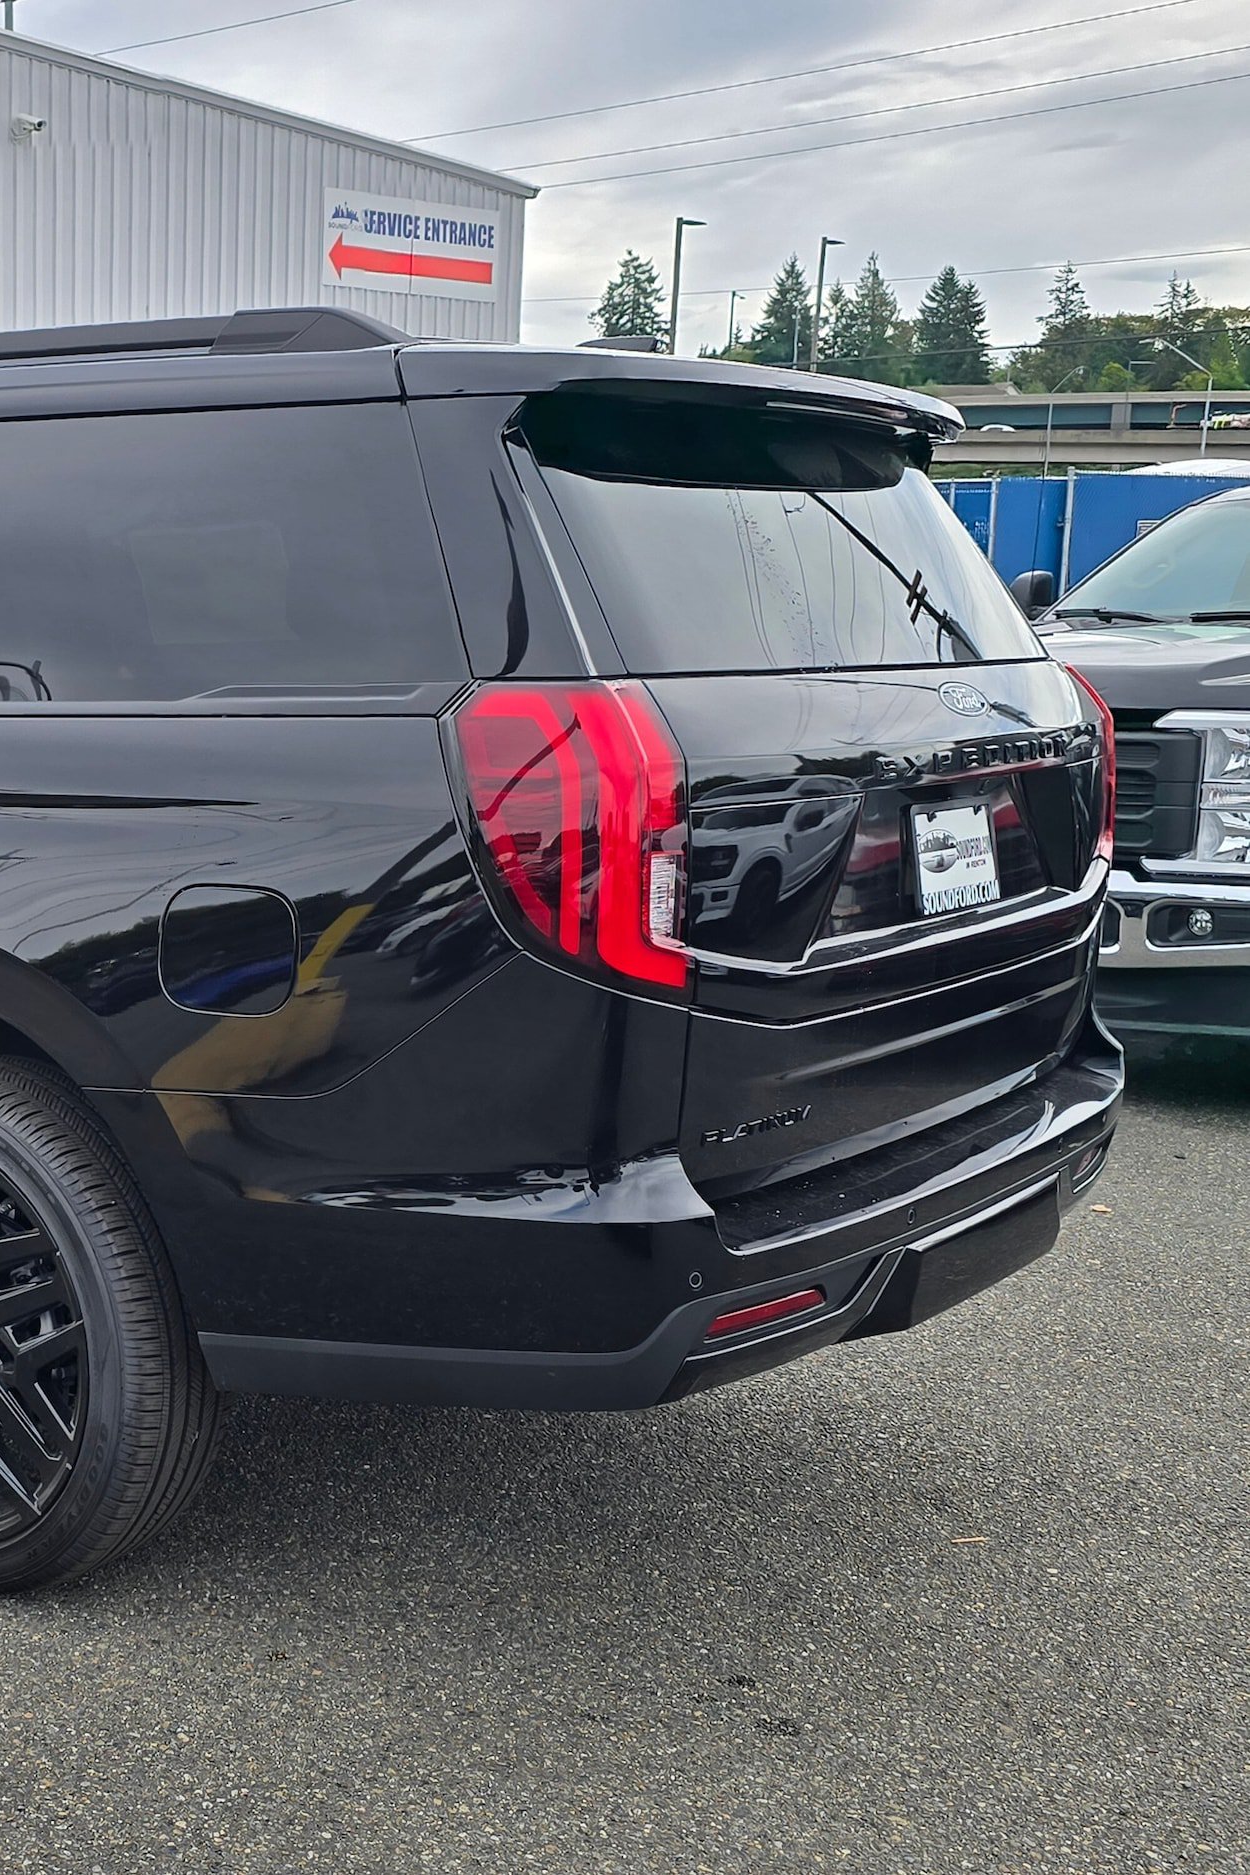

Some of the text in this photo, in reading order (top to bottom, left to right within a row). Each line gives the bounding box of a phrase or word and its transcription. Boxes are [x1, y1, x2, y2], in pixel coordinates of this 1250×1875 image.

[425, 217, 495, 249] ENTRANCE
[949, 687, 982, 710] Ford
[875, 737, 1067, 780] EXPEDITION
[923, 879, 1001, 916] SOUNDFORD.COM
[701, 1104, 812, 1147] PLATINUM
